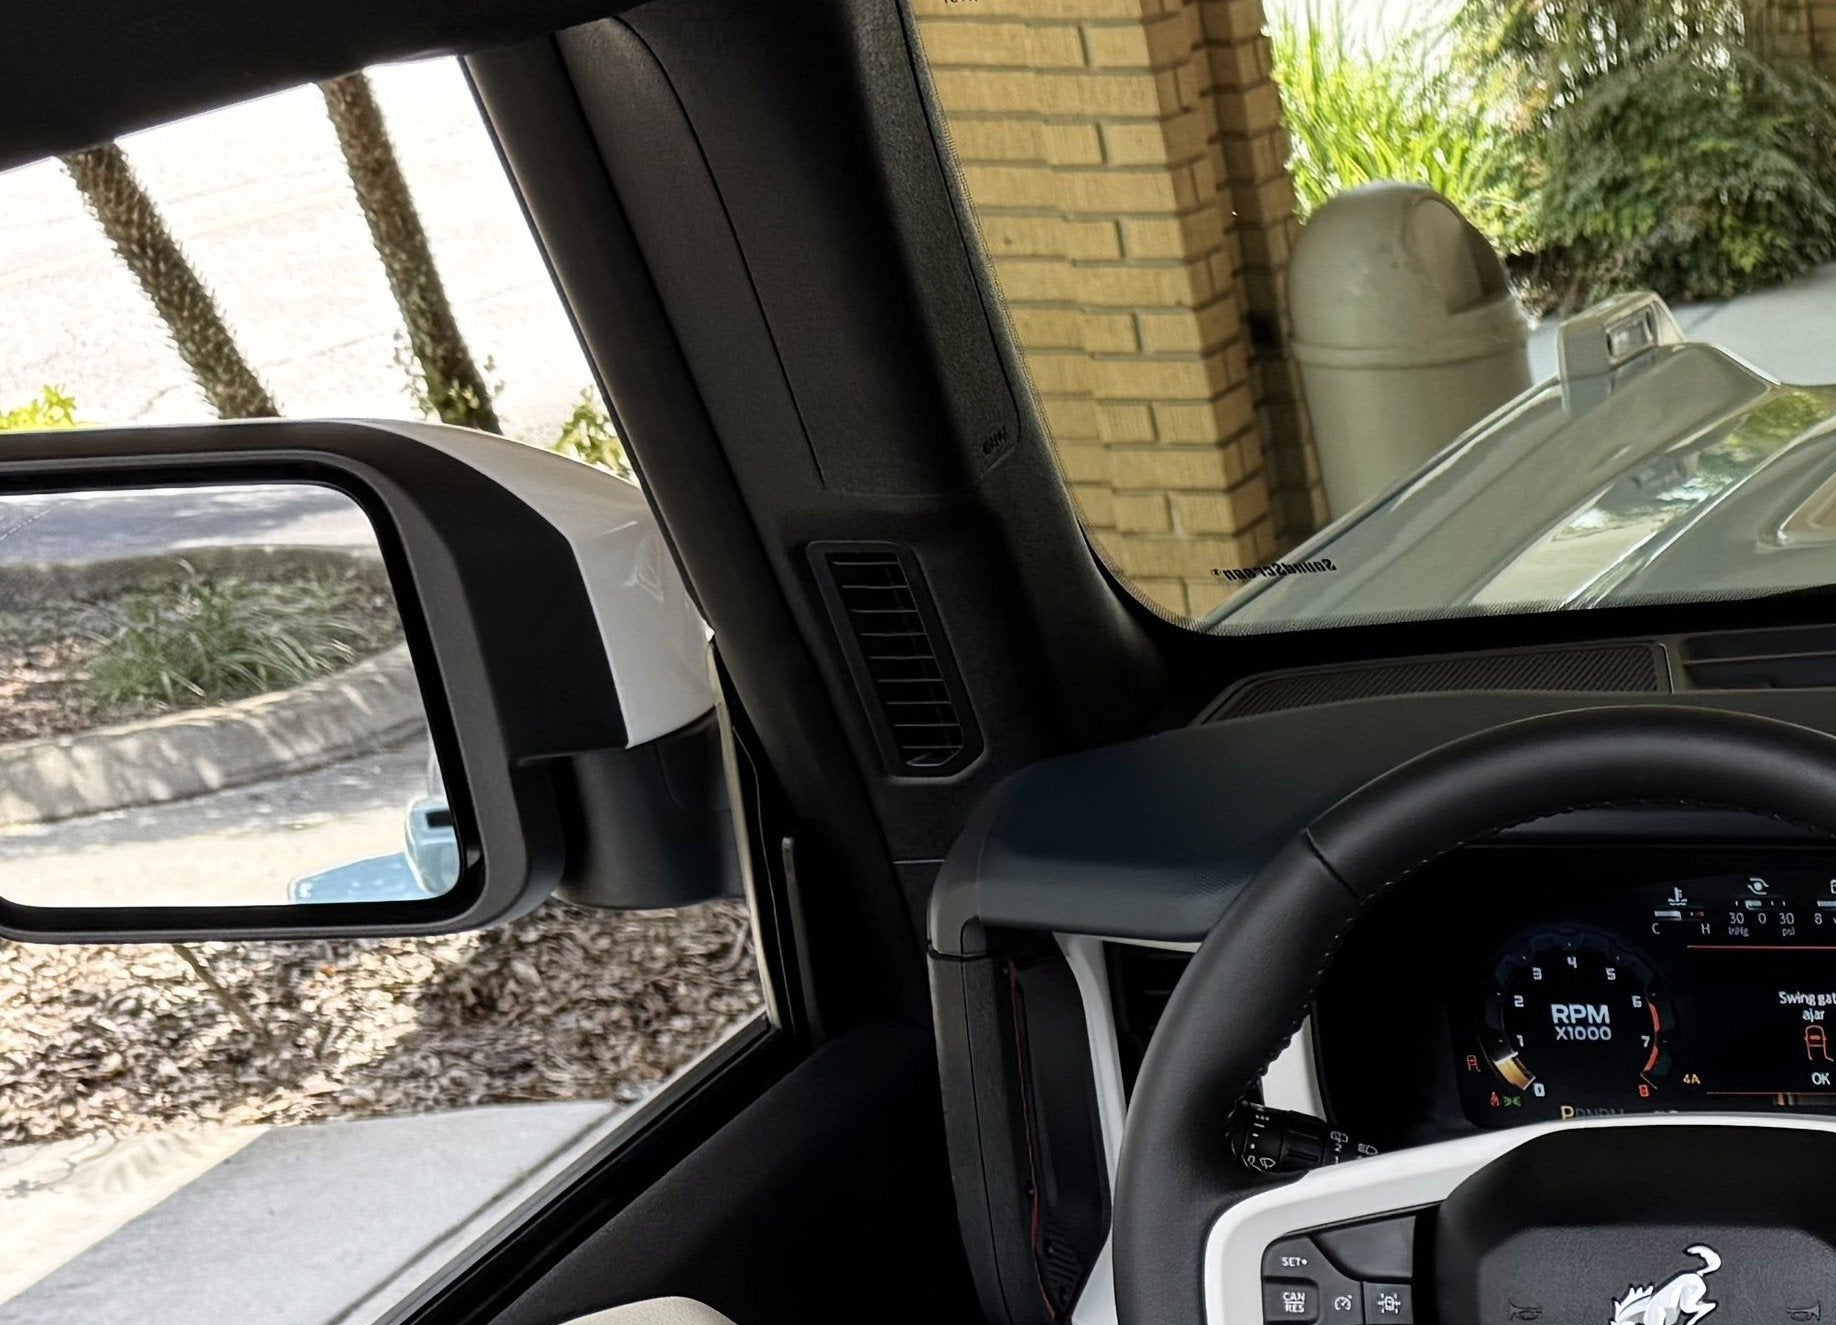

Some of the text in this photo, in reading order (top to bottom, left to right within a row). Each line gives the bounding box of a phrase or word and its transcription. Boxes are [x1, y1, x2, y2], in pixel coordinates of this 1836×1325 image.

[1729, 912, 1794, 924] 30 0 30
[1814, 913, 1822, 924] 8
[1652, 923, 1710, 935] C H
[1567, 956, 1577, 969] 4
[1532, 968, 1543, 980] 3
[1606, 968, 1616, 981] 5
[1514, 995, 1524, 1008] 2
[1632, 996, 1642, 1008] 6
[1778, 991, 1816, 1006] Swing
[1551, 1004, 1610, 1025] RPM
[1803, 1008, 1825, 1022] ajar
[1556, 1026, 1612, 1041] X1000
[1516, 1035, 1524, 1047] 1
[1641, 1035, 1650, 1047] 7
[1811, 1072, 1831, 1085] OK
[1533, 1083, 1545, 1097] 0
[1639, 1084, 1649, 1097] 8
[1283, 1292, 1306, 1302] CAN
[1284, 1304, 1305, 1313] RES
